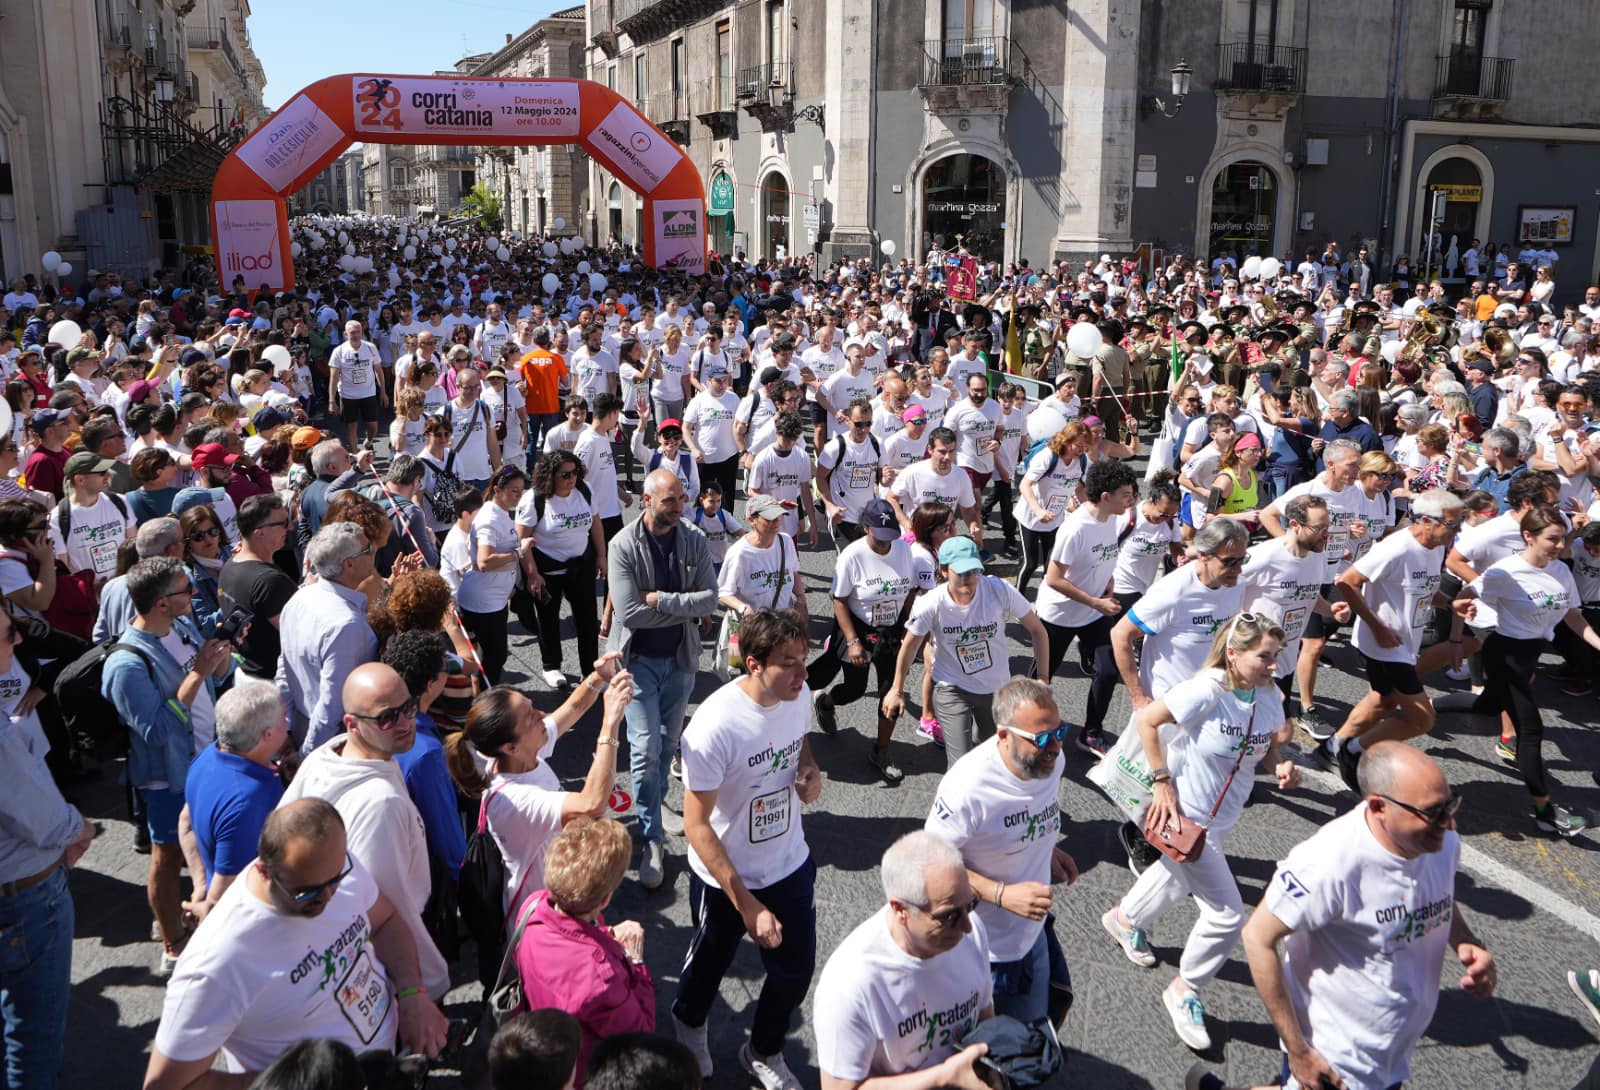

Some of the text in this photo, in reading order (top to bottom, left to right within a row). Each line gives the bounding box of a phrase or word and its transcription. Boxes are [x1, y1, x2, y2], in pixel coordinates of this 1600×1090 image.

[357, 80, 401, 108] 20
[412, 88, 456, 109] corri
[514, 96, 564, 105] Domenica
[361, 103, 404, 130] 24
[424, 103, 493, 126] catania
[500, 106, 577, 117] 12 Maggio 2024
[516, 117, 561, 126] ore 10.00
[227, 252, 272, 272] iliad
[943, 622, 963, 634] corri
[1220, 722, 1243, 737] corri
[748, 742, 775, 767] corri
[755, 809, 785, 827] 21991
[1004, 804, 1030, 828] corri
[1375, 896, 1408, 924] corri
[290, 944, 321, 984] corri
[329, 914, 366, 959] catania
[358, 980, 383, 1017] 5190
[898, 990, 978, 1038] corri catania
